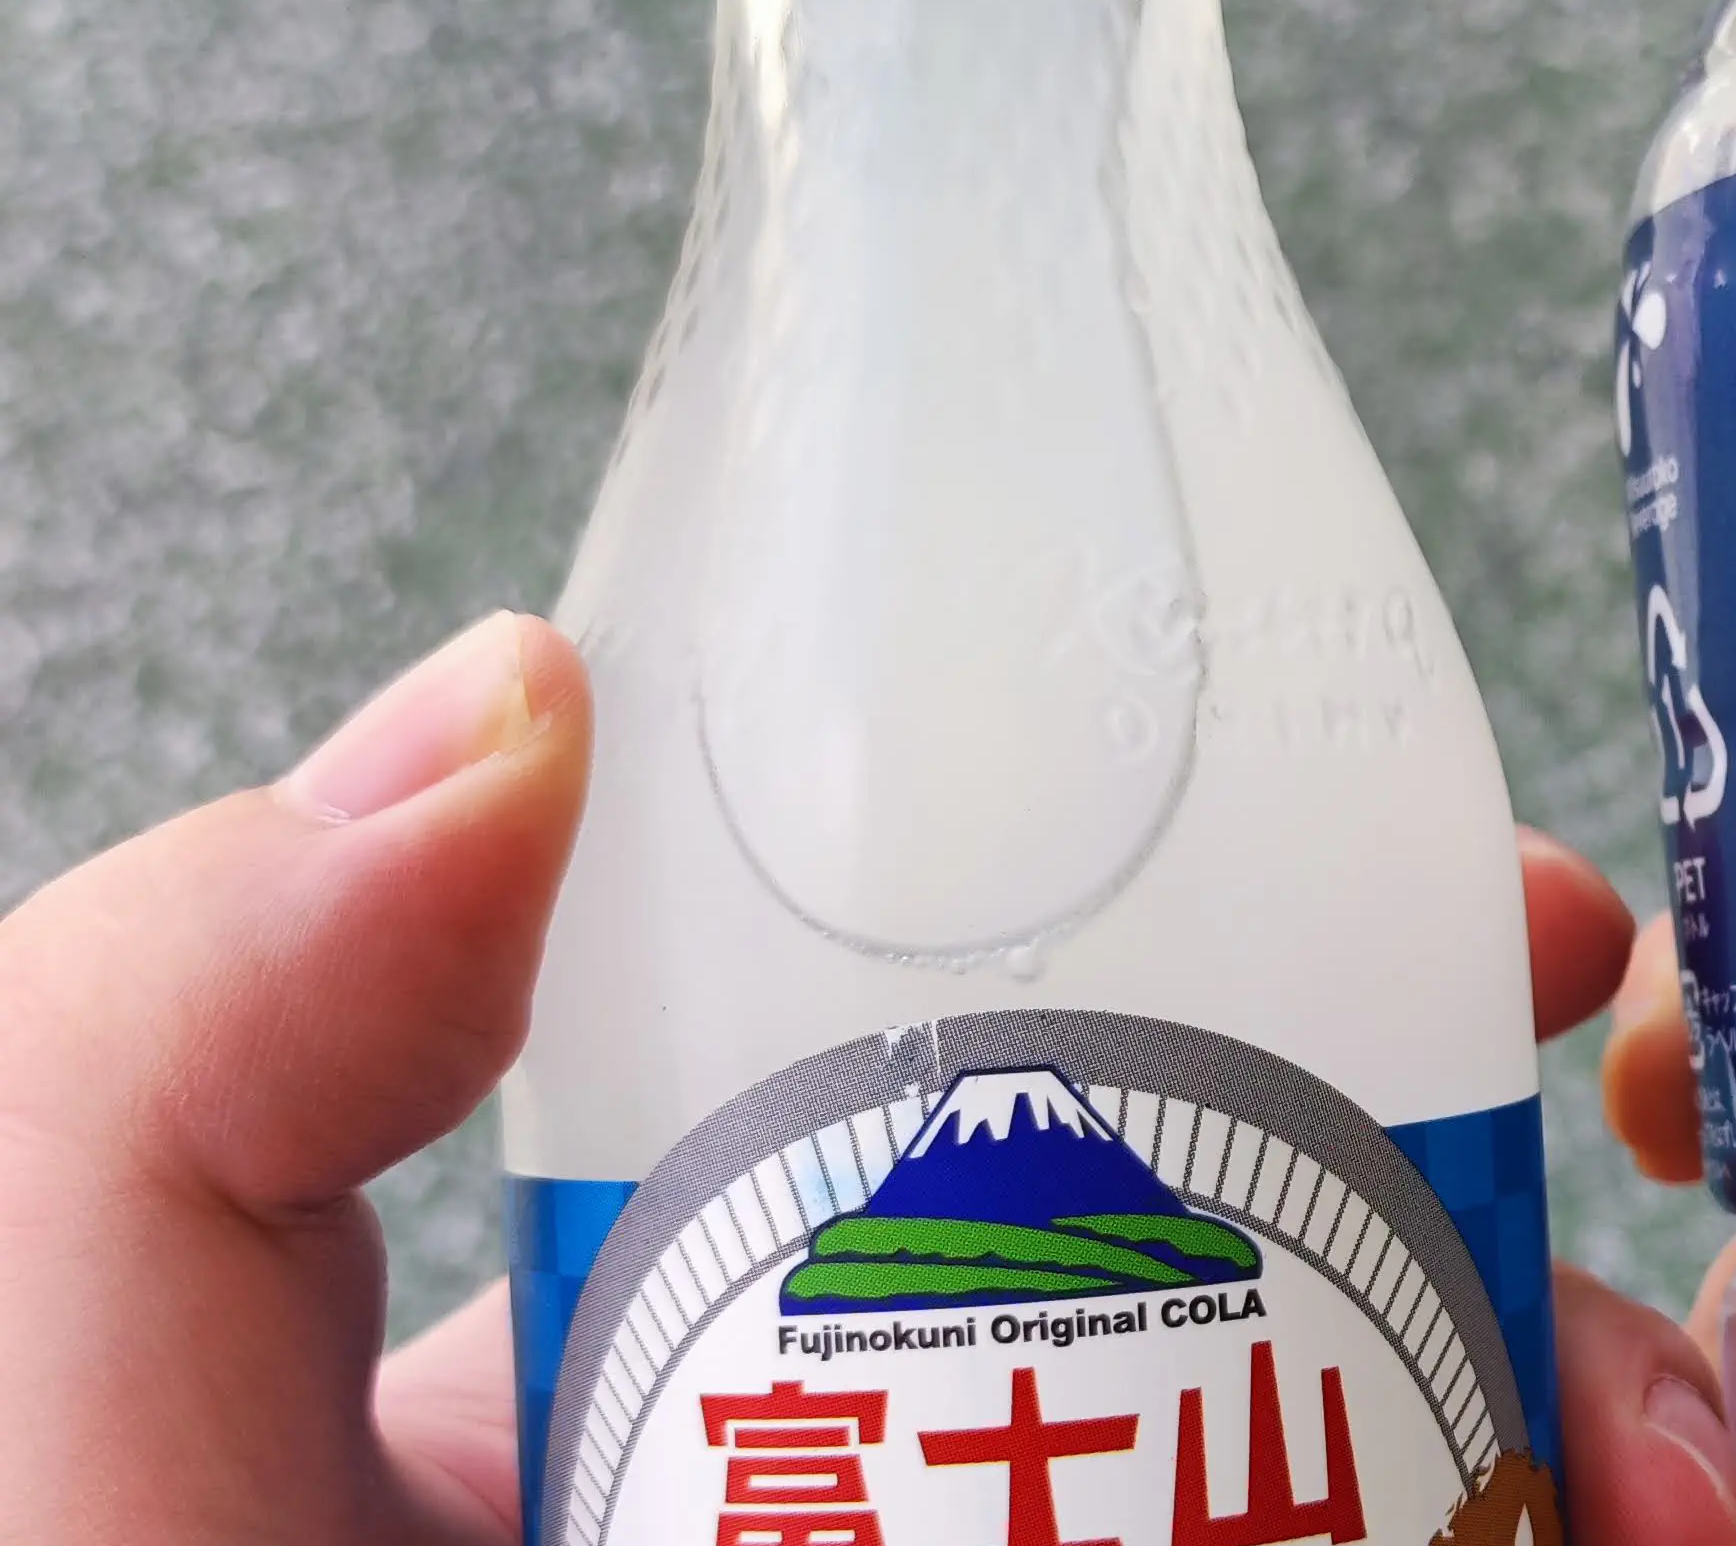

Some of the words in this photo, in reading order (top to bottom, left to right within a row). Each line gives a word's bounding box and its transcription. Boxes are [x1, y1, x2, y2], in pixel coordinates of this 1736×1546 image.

[1673, 856, 1706, 902] PET
[778, 1317, 977, 1360] Fujinokuni
[990, 1303, 1149, 1348] Original
[1160, 1288, 1266, 1327] COLA
